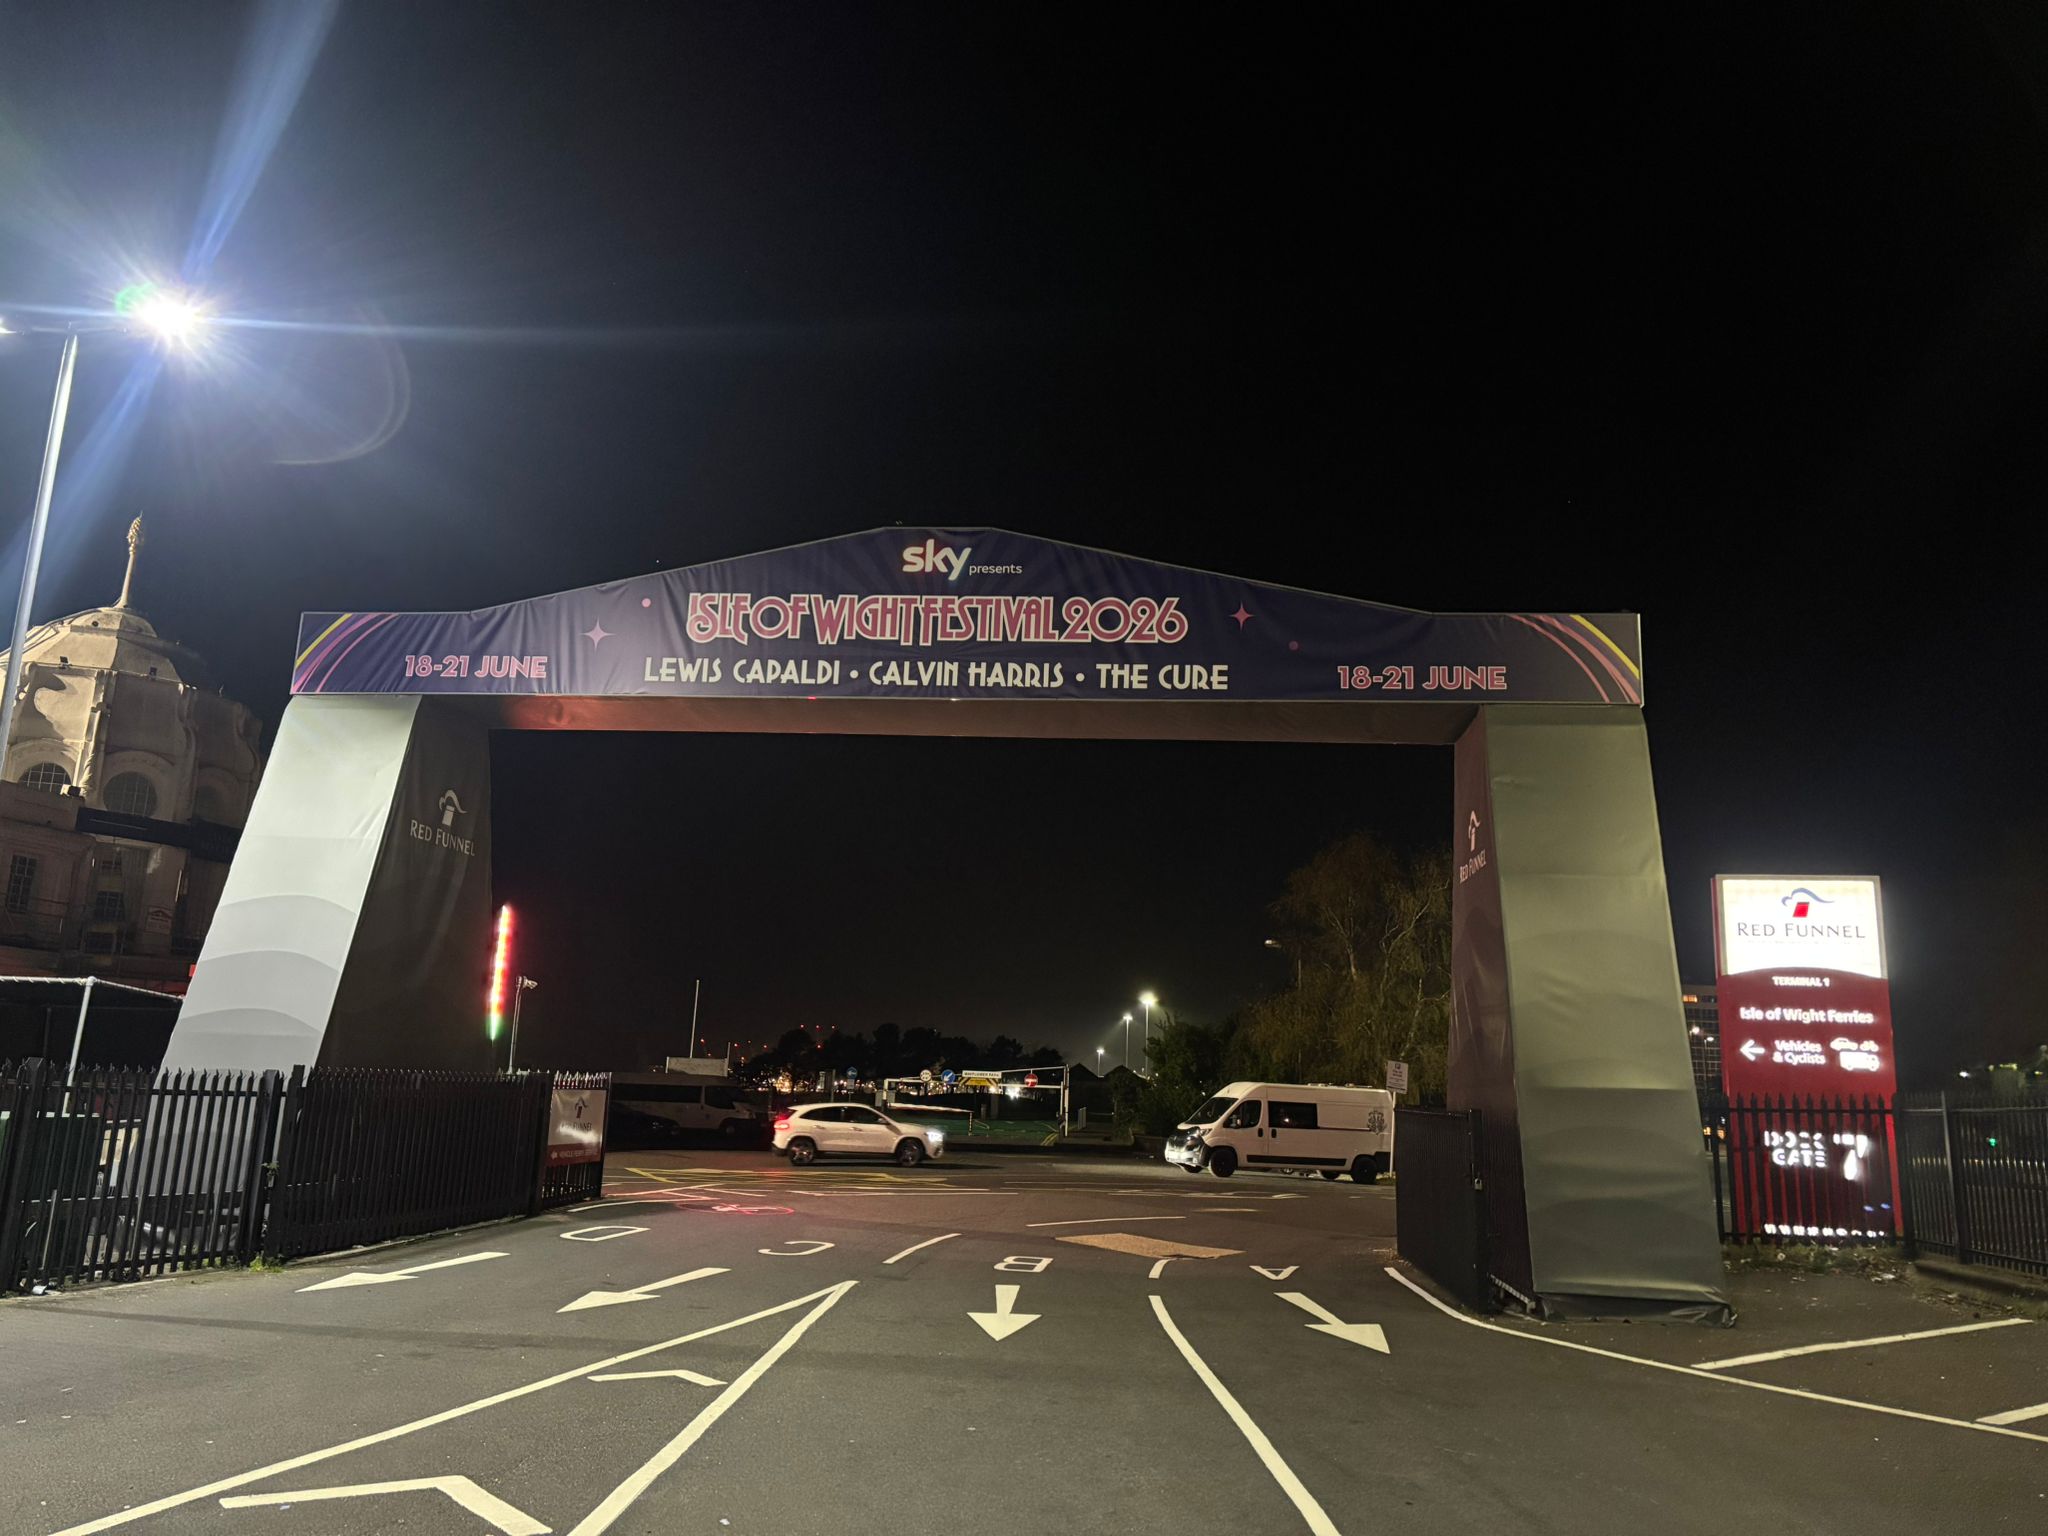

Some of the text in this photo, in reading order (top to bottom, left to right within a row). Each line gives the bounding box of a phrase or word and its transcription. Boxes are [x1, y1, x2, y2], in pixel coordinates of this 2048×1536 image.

[902, 539, 1022, 580] sky presents
[1060, 596, 1189, 643] 2026
[405, 655, 547, 678] 18-21 JUNE
[644, 657, 1229, 690] LEWIS CAPALDI CALVIN HARRIS THE CURE
[1337, 665, 1507, 690] 18-21 JUNE
[410, 820, 475, 857] RED FUNNEL
[1459, 849, 1487, 884] RED FUNNEL
[1737, 922, 1866, 938] RED FUNNEL
[1772, 976, 1830, 987] TERMINAL 1
[1739, 1007, 1874, 1024] Isle of Wight Ferries
[1774, 1040, 1822, 1052] Vehicles
[1784, 1053, 1826, 1065] Cyclists
